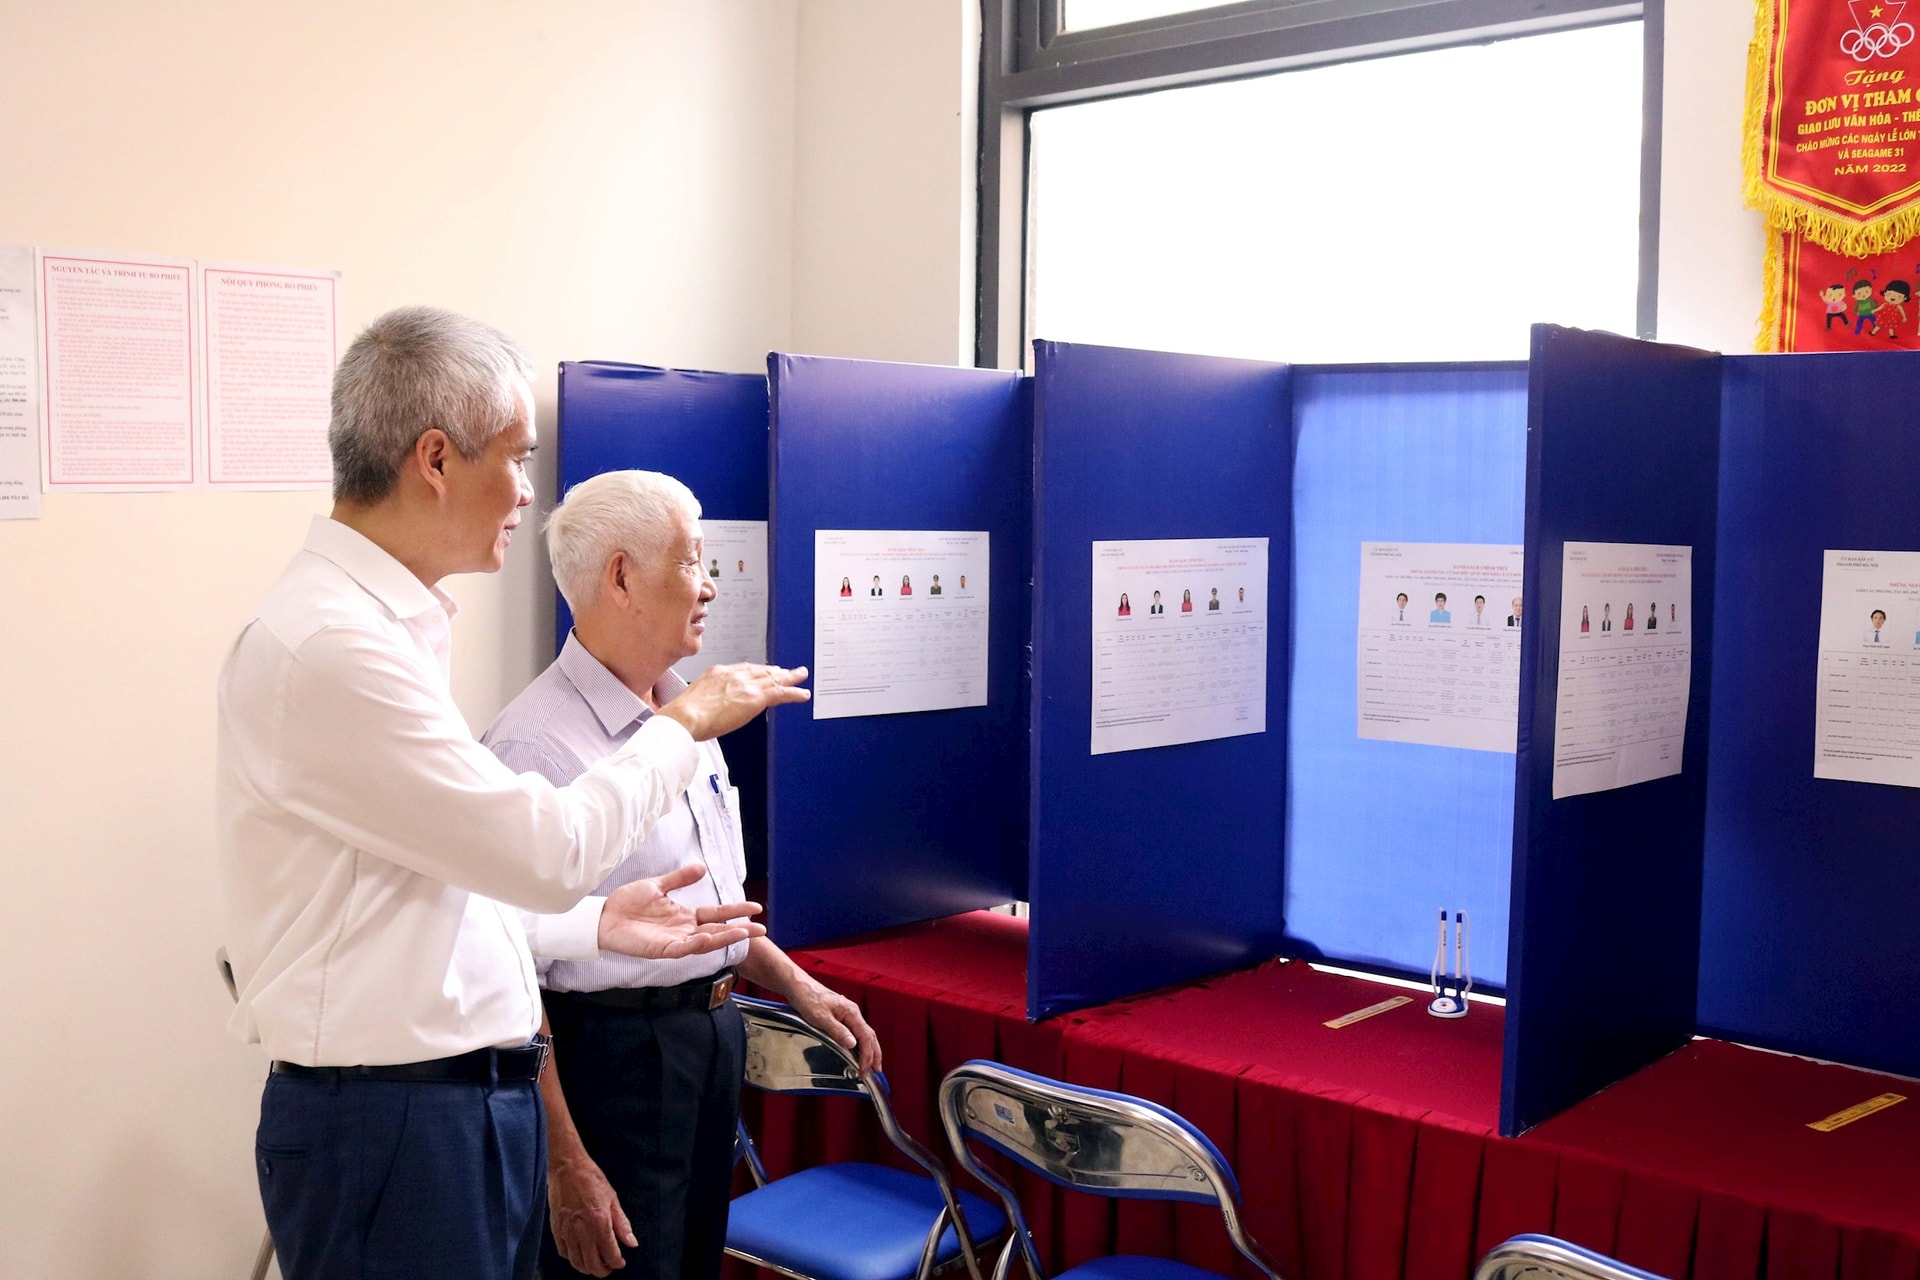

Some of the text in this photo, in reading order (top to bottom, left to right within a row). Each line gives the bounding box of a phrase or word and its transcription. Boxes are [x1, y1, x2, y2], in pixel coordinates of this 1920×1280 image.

[1844, 69, 1906, 88] Tặng
[1805, 96, 1838, 116] ĐƠN
[1841, 93, 1860, 112] VỊ
[1863, 88, 1912, 108] THAM
[1797, 122, 1822, 135] GIAO
[1823, 117, 1841, 131] LƯU
[1843, 114, 1867, 127] VĂN
[1869, 111, 1892, 126] HÓA
[1796, 140, 1819, 153] CHÀO
[1841, 132, 1860, 145] CÁC
[1861, 131, 1886, 144] NGÀY
[1887, 127, 1898, 142] LỄ
[1899, 128, 1917, 141] LỚN
[1838, 147, 1905, 160] VÀ SEAGAME 31
[1834, 163, 1907, 176] NĂM 2022
